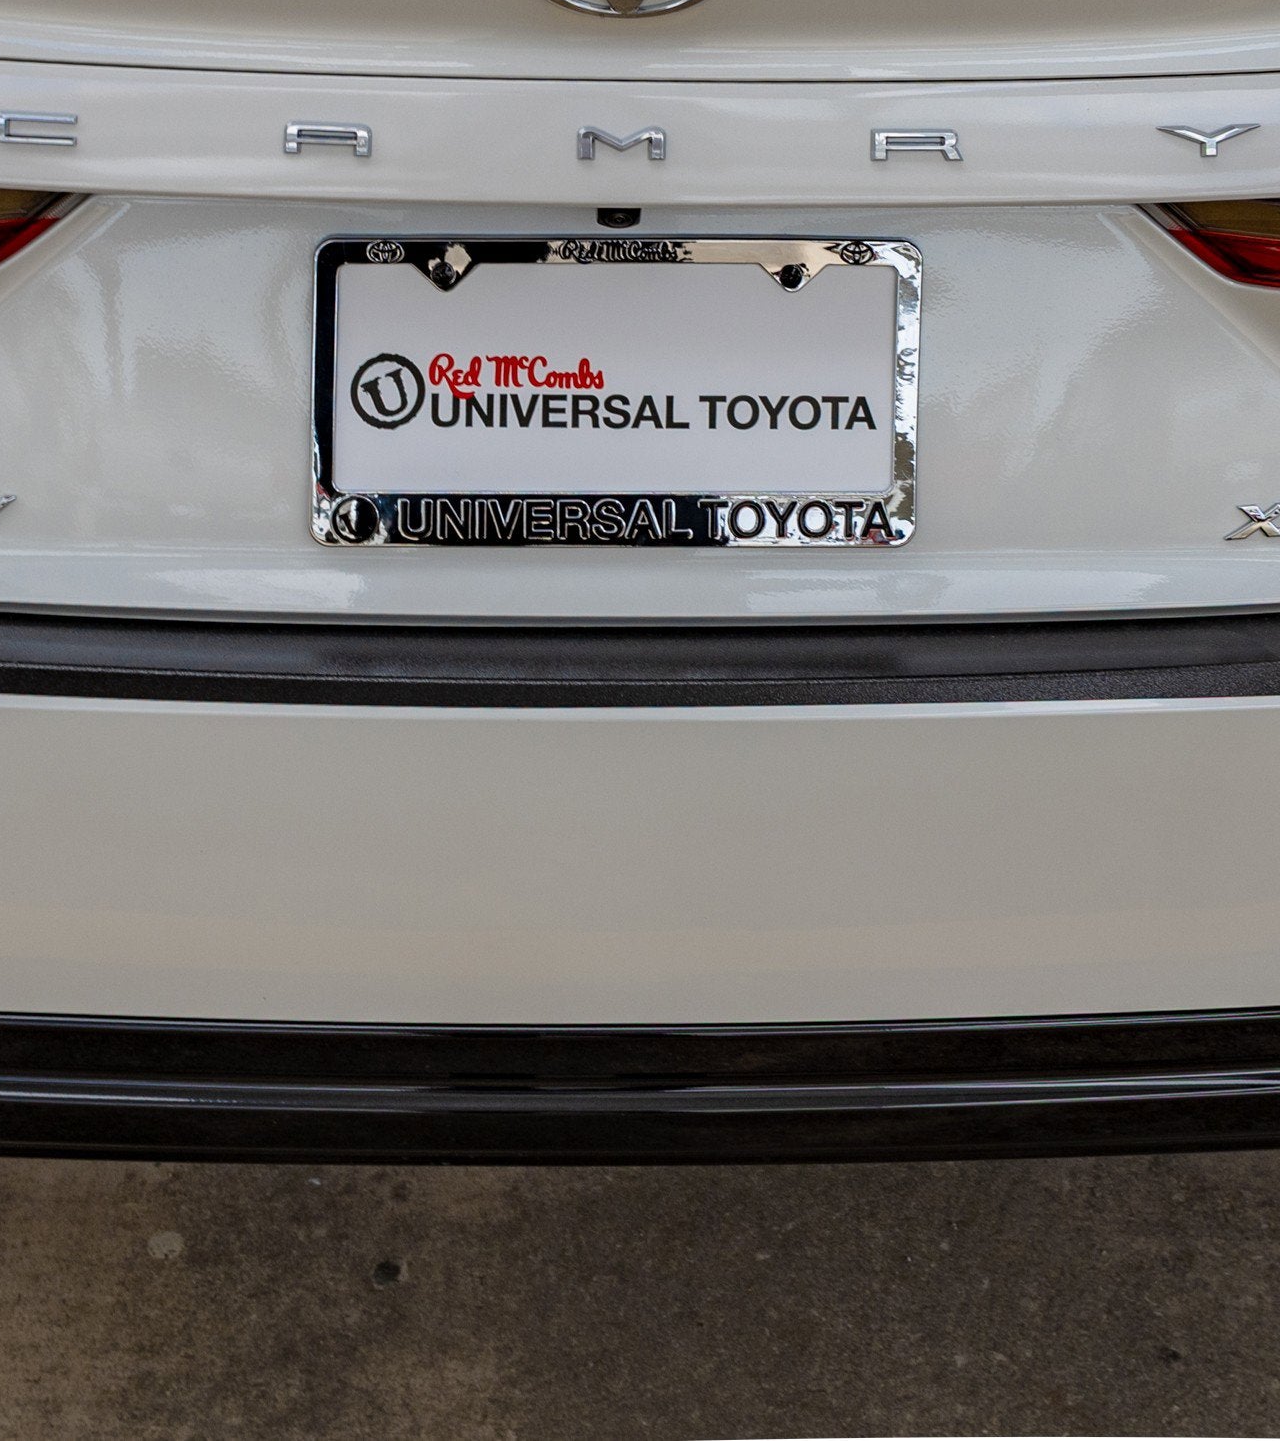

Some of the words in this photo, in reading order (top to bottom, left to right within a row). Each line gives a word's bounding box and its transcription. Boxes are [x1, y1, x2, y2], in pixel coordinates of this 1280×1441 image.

[428, 353, 482, 399] Red
[485, 355, 605, 390] McCombs
[430, 393, 690, 430] UNIVERSAL
[699, 394, 878, 431] TOYOTA
[397, 498, 694, 541] UNIVERSAL
[698, 499, 897, 541] TOYOTA
